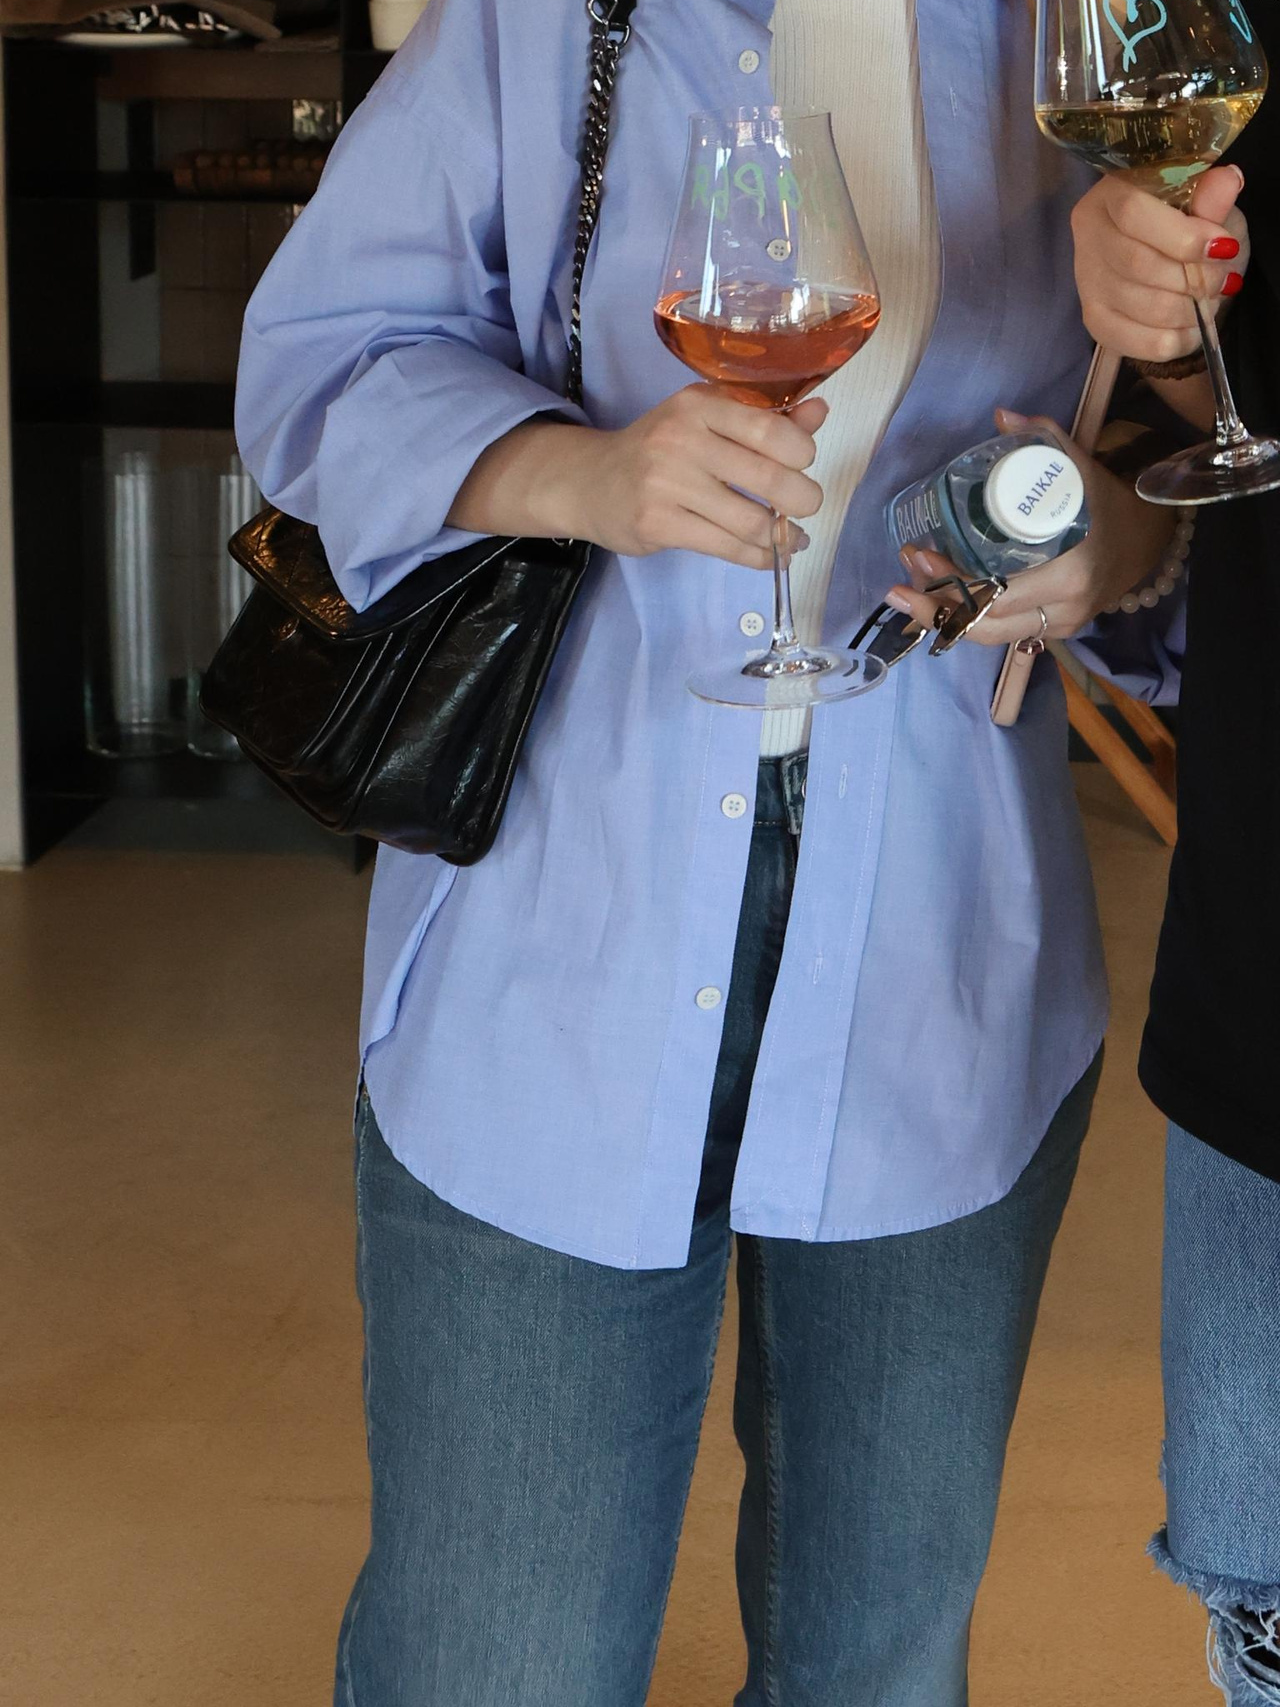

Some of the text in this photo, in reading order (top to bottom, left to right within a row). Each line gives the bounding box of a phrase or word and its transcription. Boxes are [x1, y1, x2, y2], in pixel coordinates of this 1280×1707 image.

[1016, 460, 1064, 517] BAIKAL
[1049, 492, 1073, 520] RUSSIA
[896, 489, 942, 543] BAIKAL
